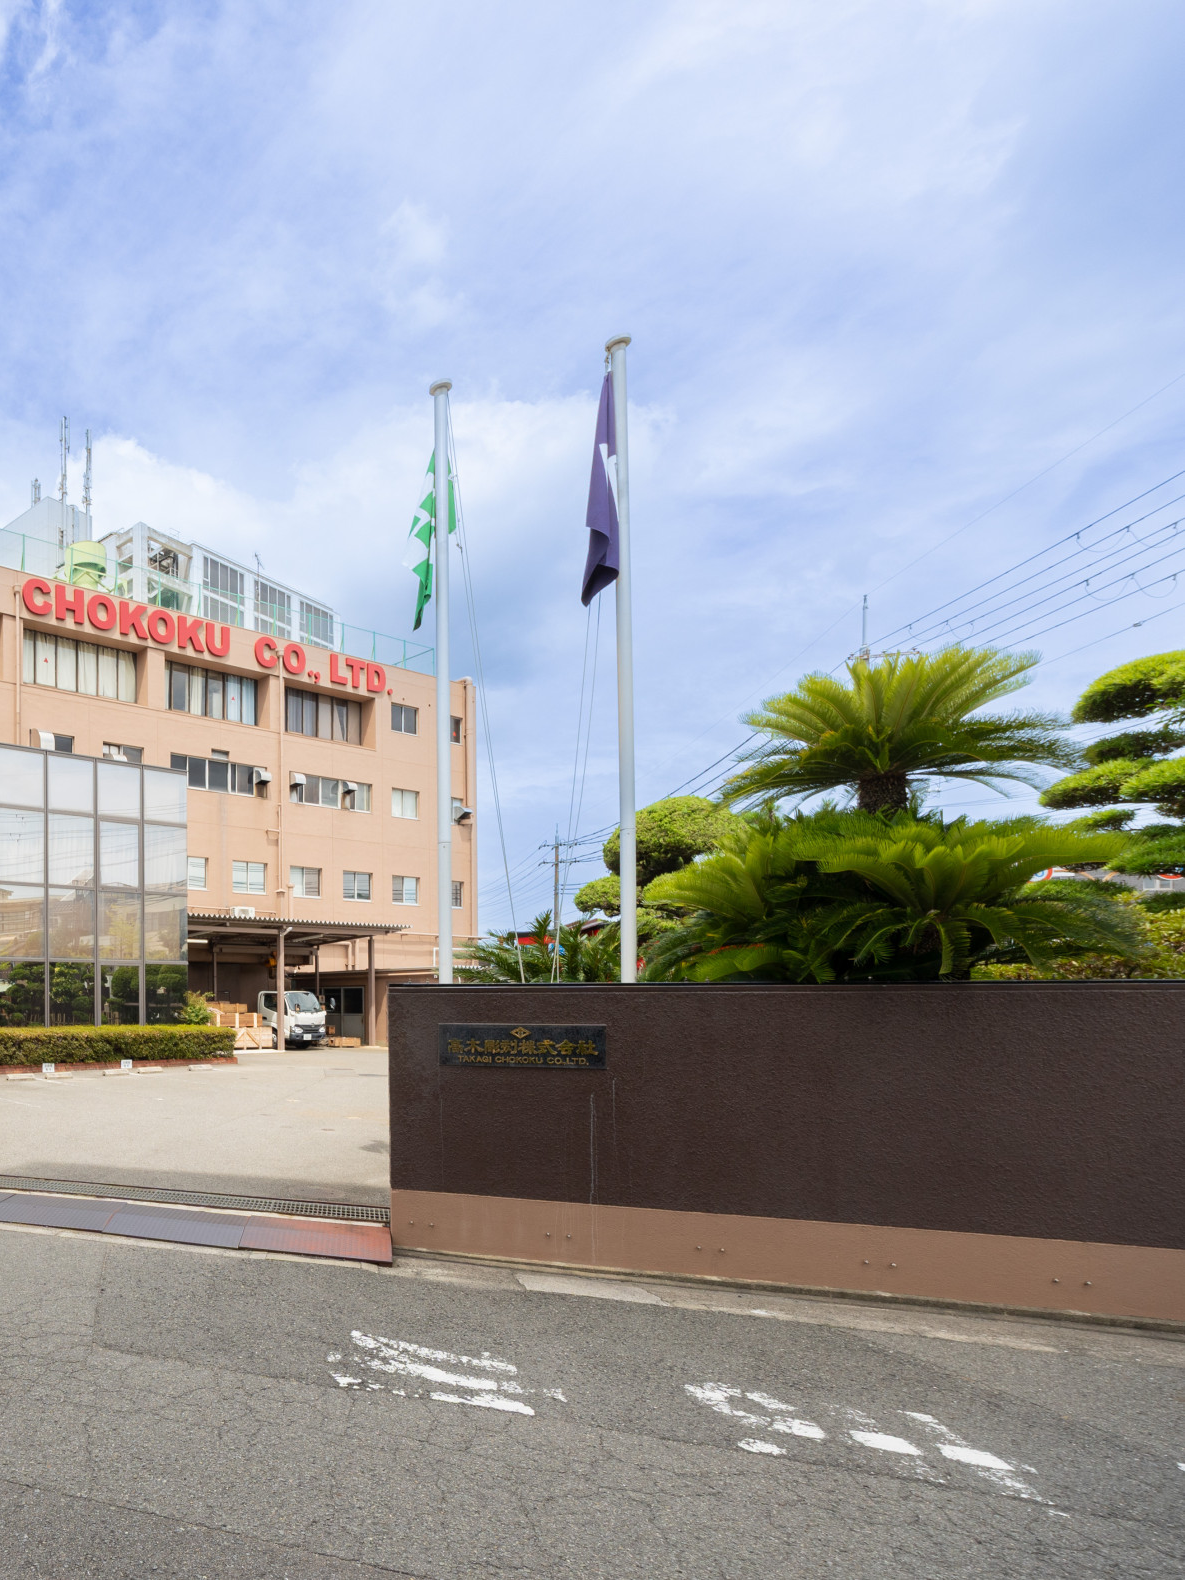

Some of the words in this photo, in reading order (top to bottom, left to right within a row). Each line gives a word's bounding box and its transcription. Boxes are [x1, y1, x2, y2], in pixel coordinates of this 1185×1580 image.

[22, 578, 231, 657] CHOKOKU
[458, 1055, 493, 1064] TAKAGI
[495, 1056, 544, 1065] CHOKOKU
